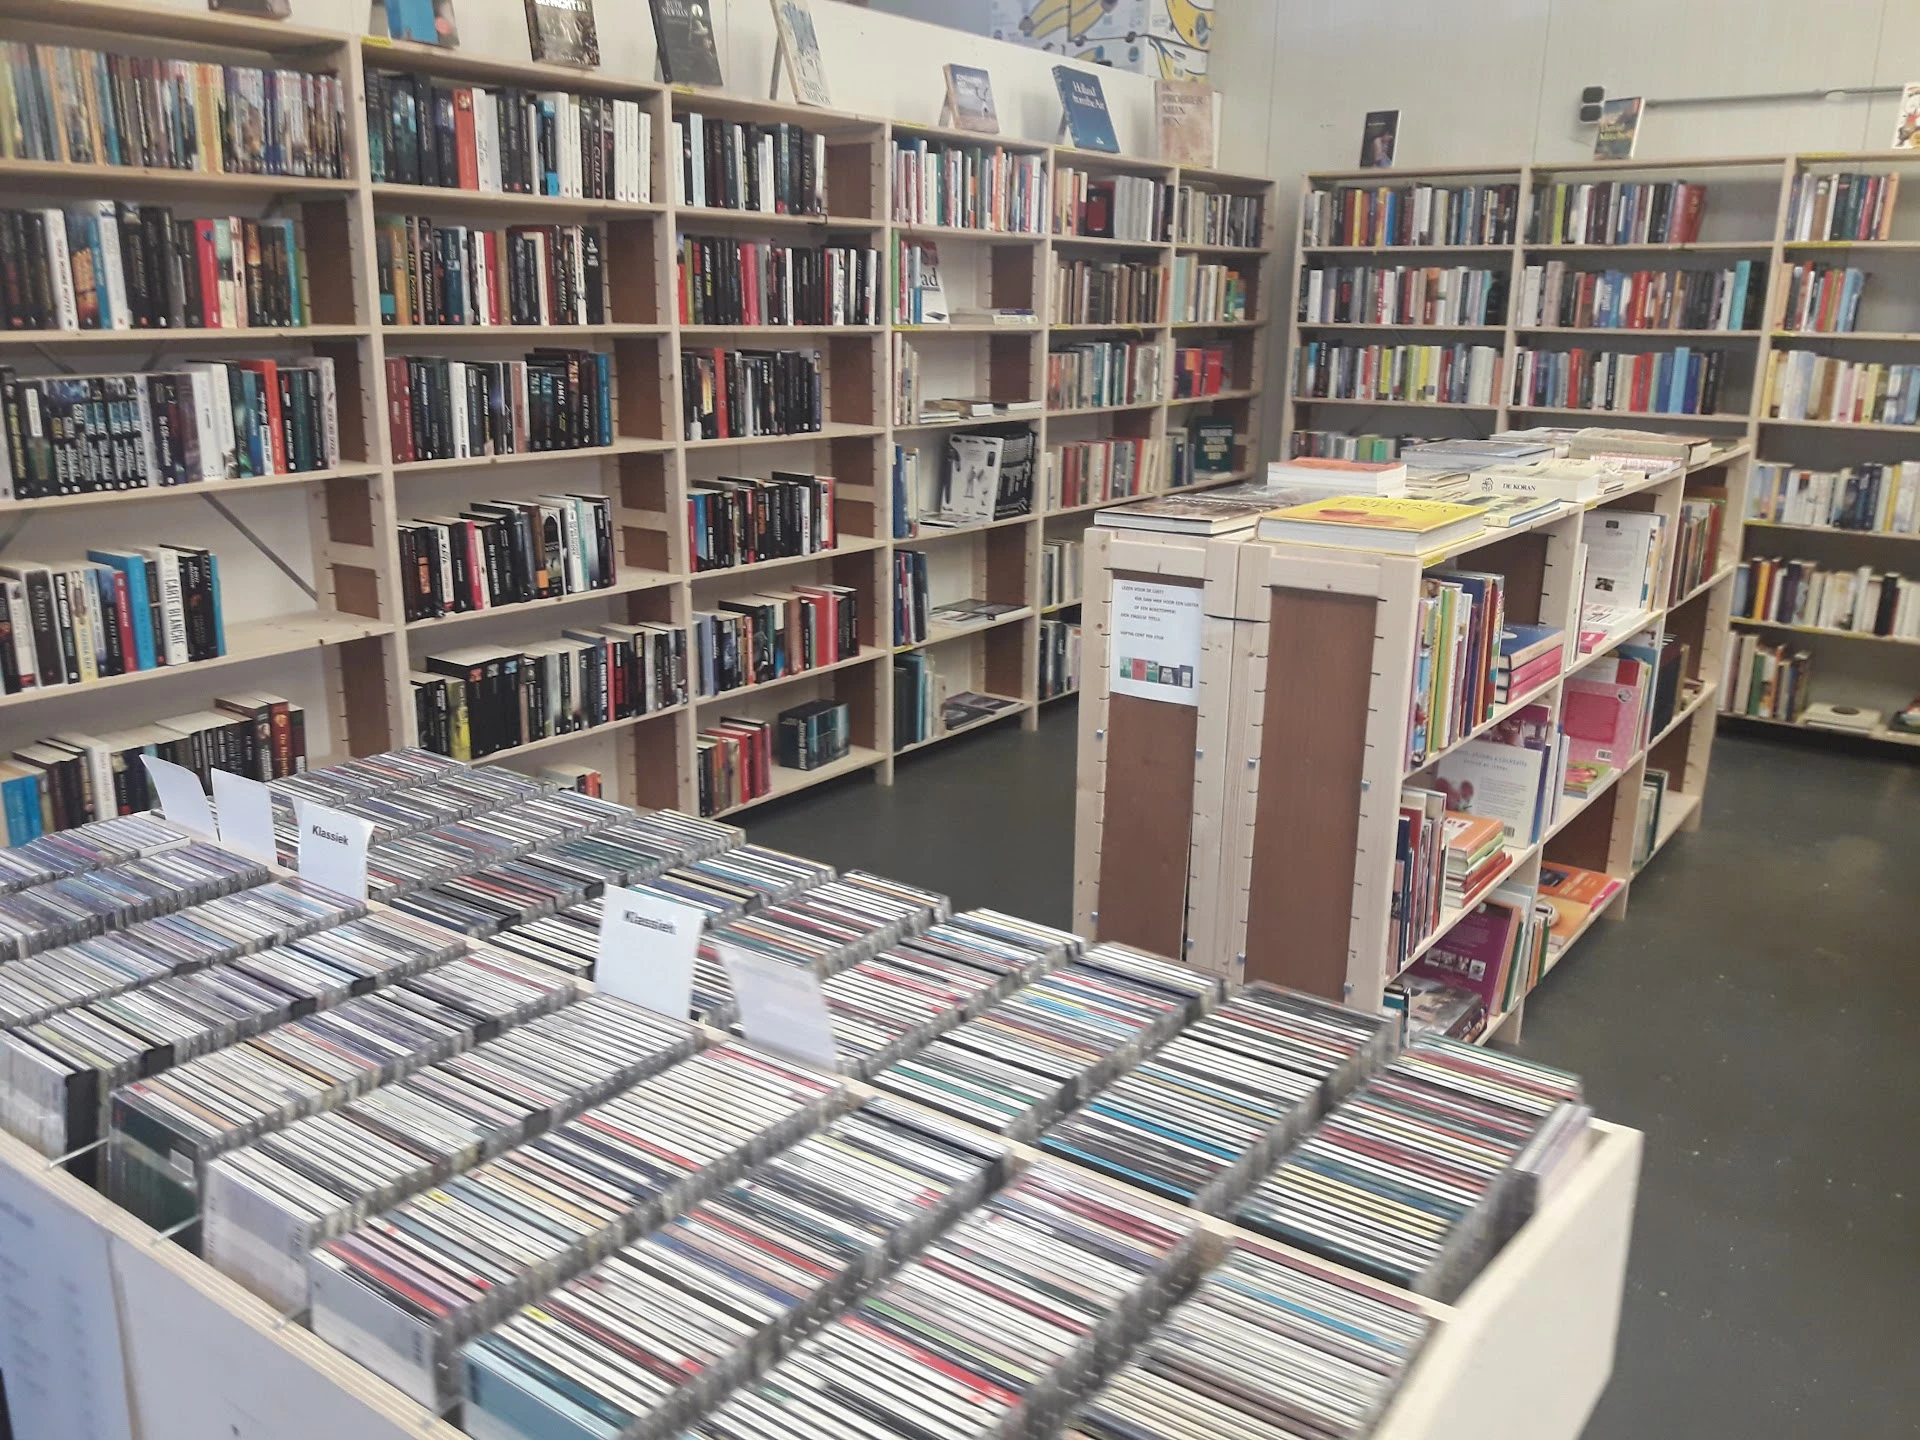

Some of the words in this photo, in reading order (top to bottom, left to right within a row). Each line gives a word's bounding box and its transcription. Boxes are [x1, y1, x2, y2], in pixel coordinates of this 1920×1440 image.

[164, 578, 182, 608] CARTE
[168, 608, 186, 645] BLANCHE
[799, 719, 807, 748] James
[799, 749, 808, 770] Bond
[312, 824, 349, 846] Klassiek
[623, 908, 677, 935] Klassiek
